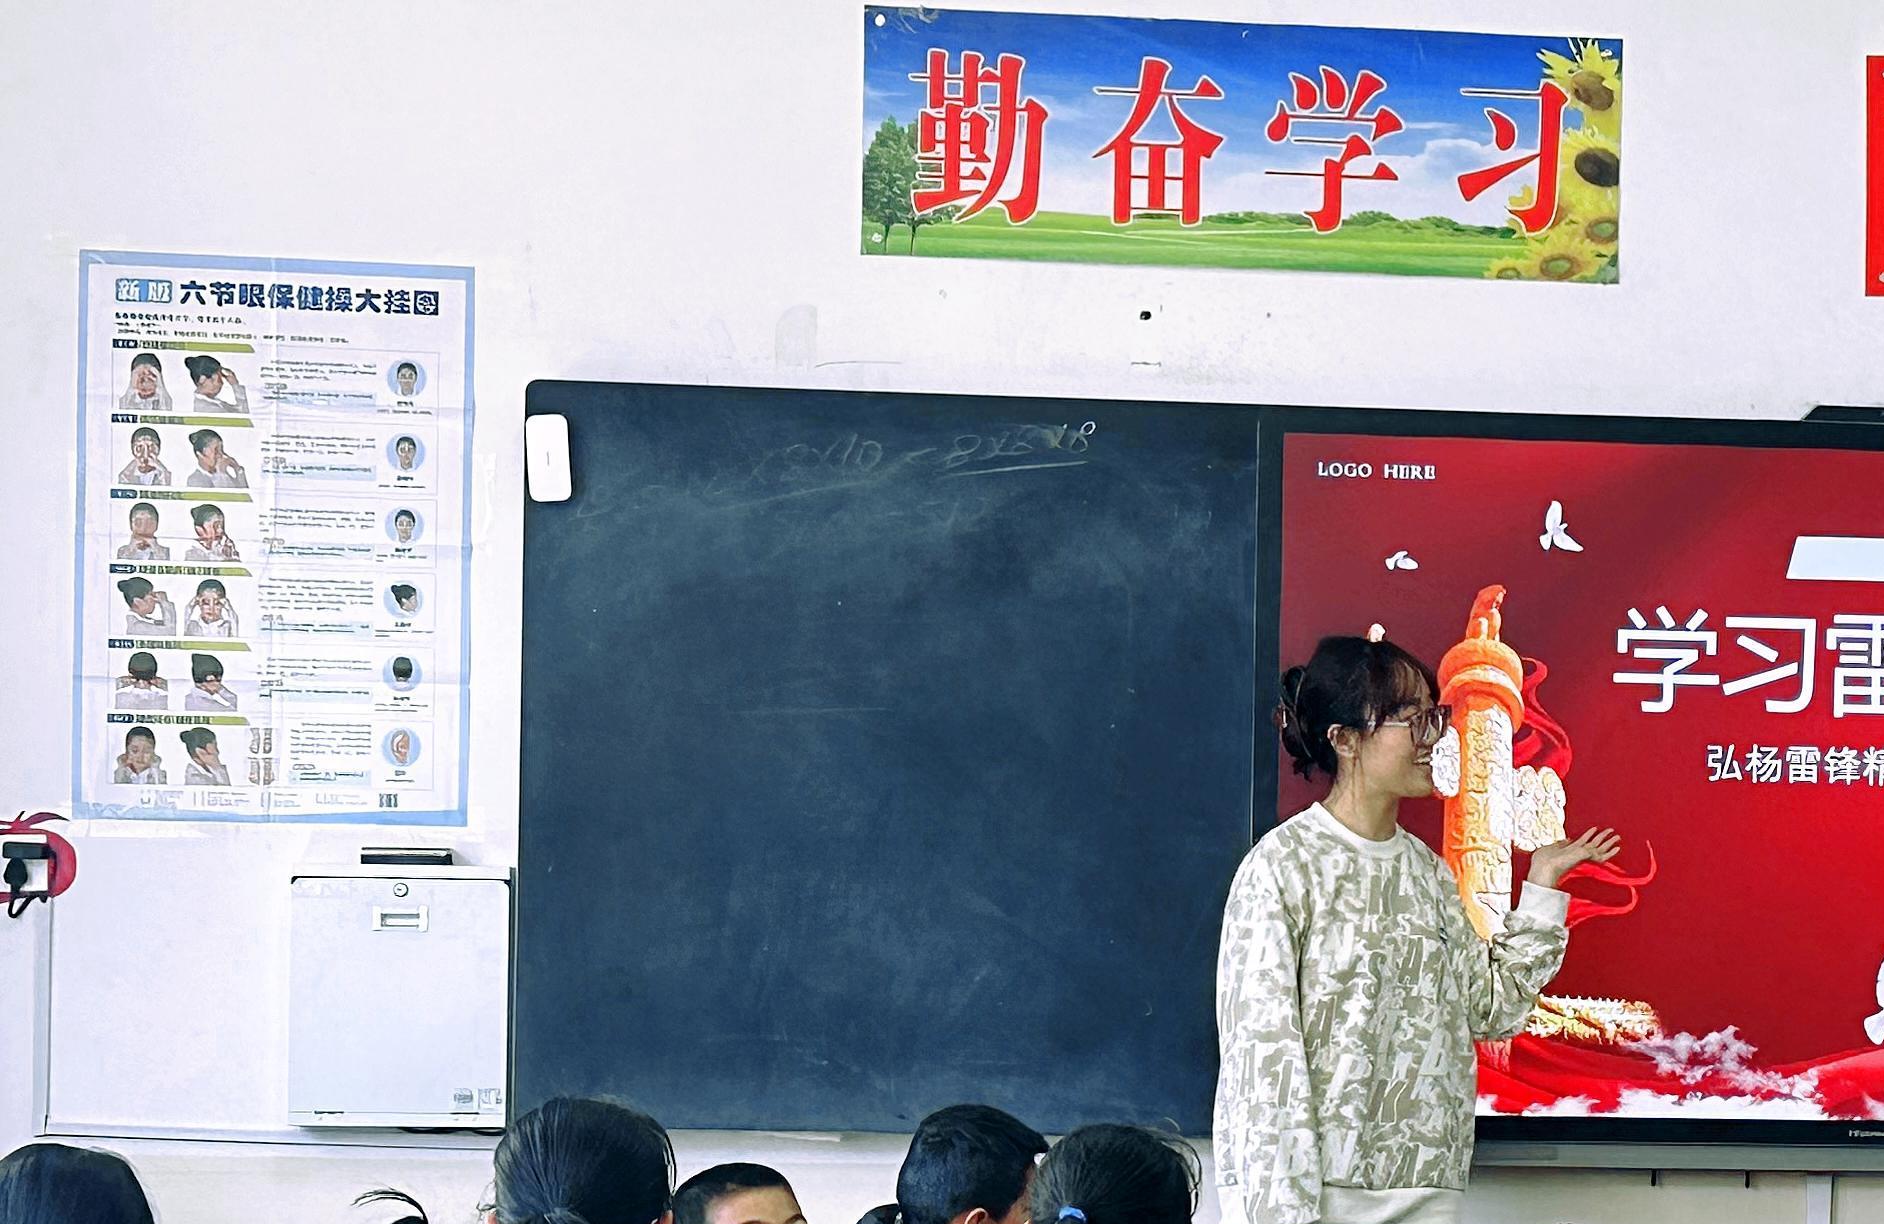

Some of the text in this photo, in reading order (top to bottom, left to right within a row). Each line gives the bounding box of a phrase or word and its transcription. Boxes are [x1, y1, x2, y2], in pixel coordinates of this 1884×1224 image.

[908, 47, 1570, 236] 勤奋学习
[180, 279, 440, 316] 六节眼保健操大挂图
[1318, 461, 1373, 478] LOGO
